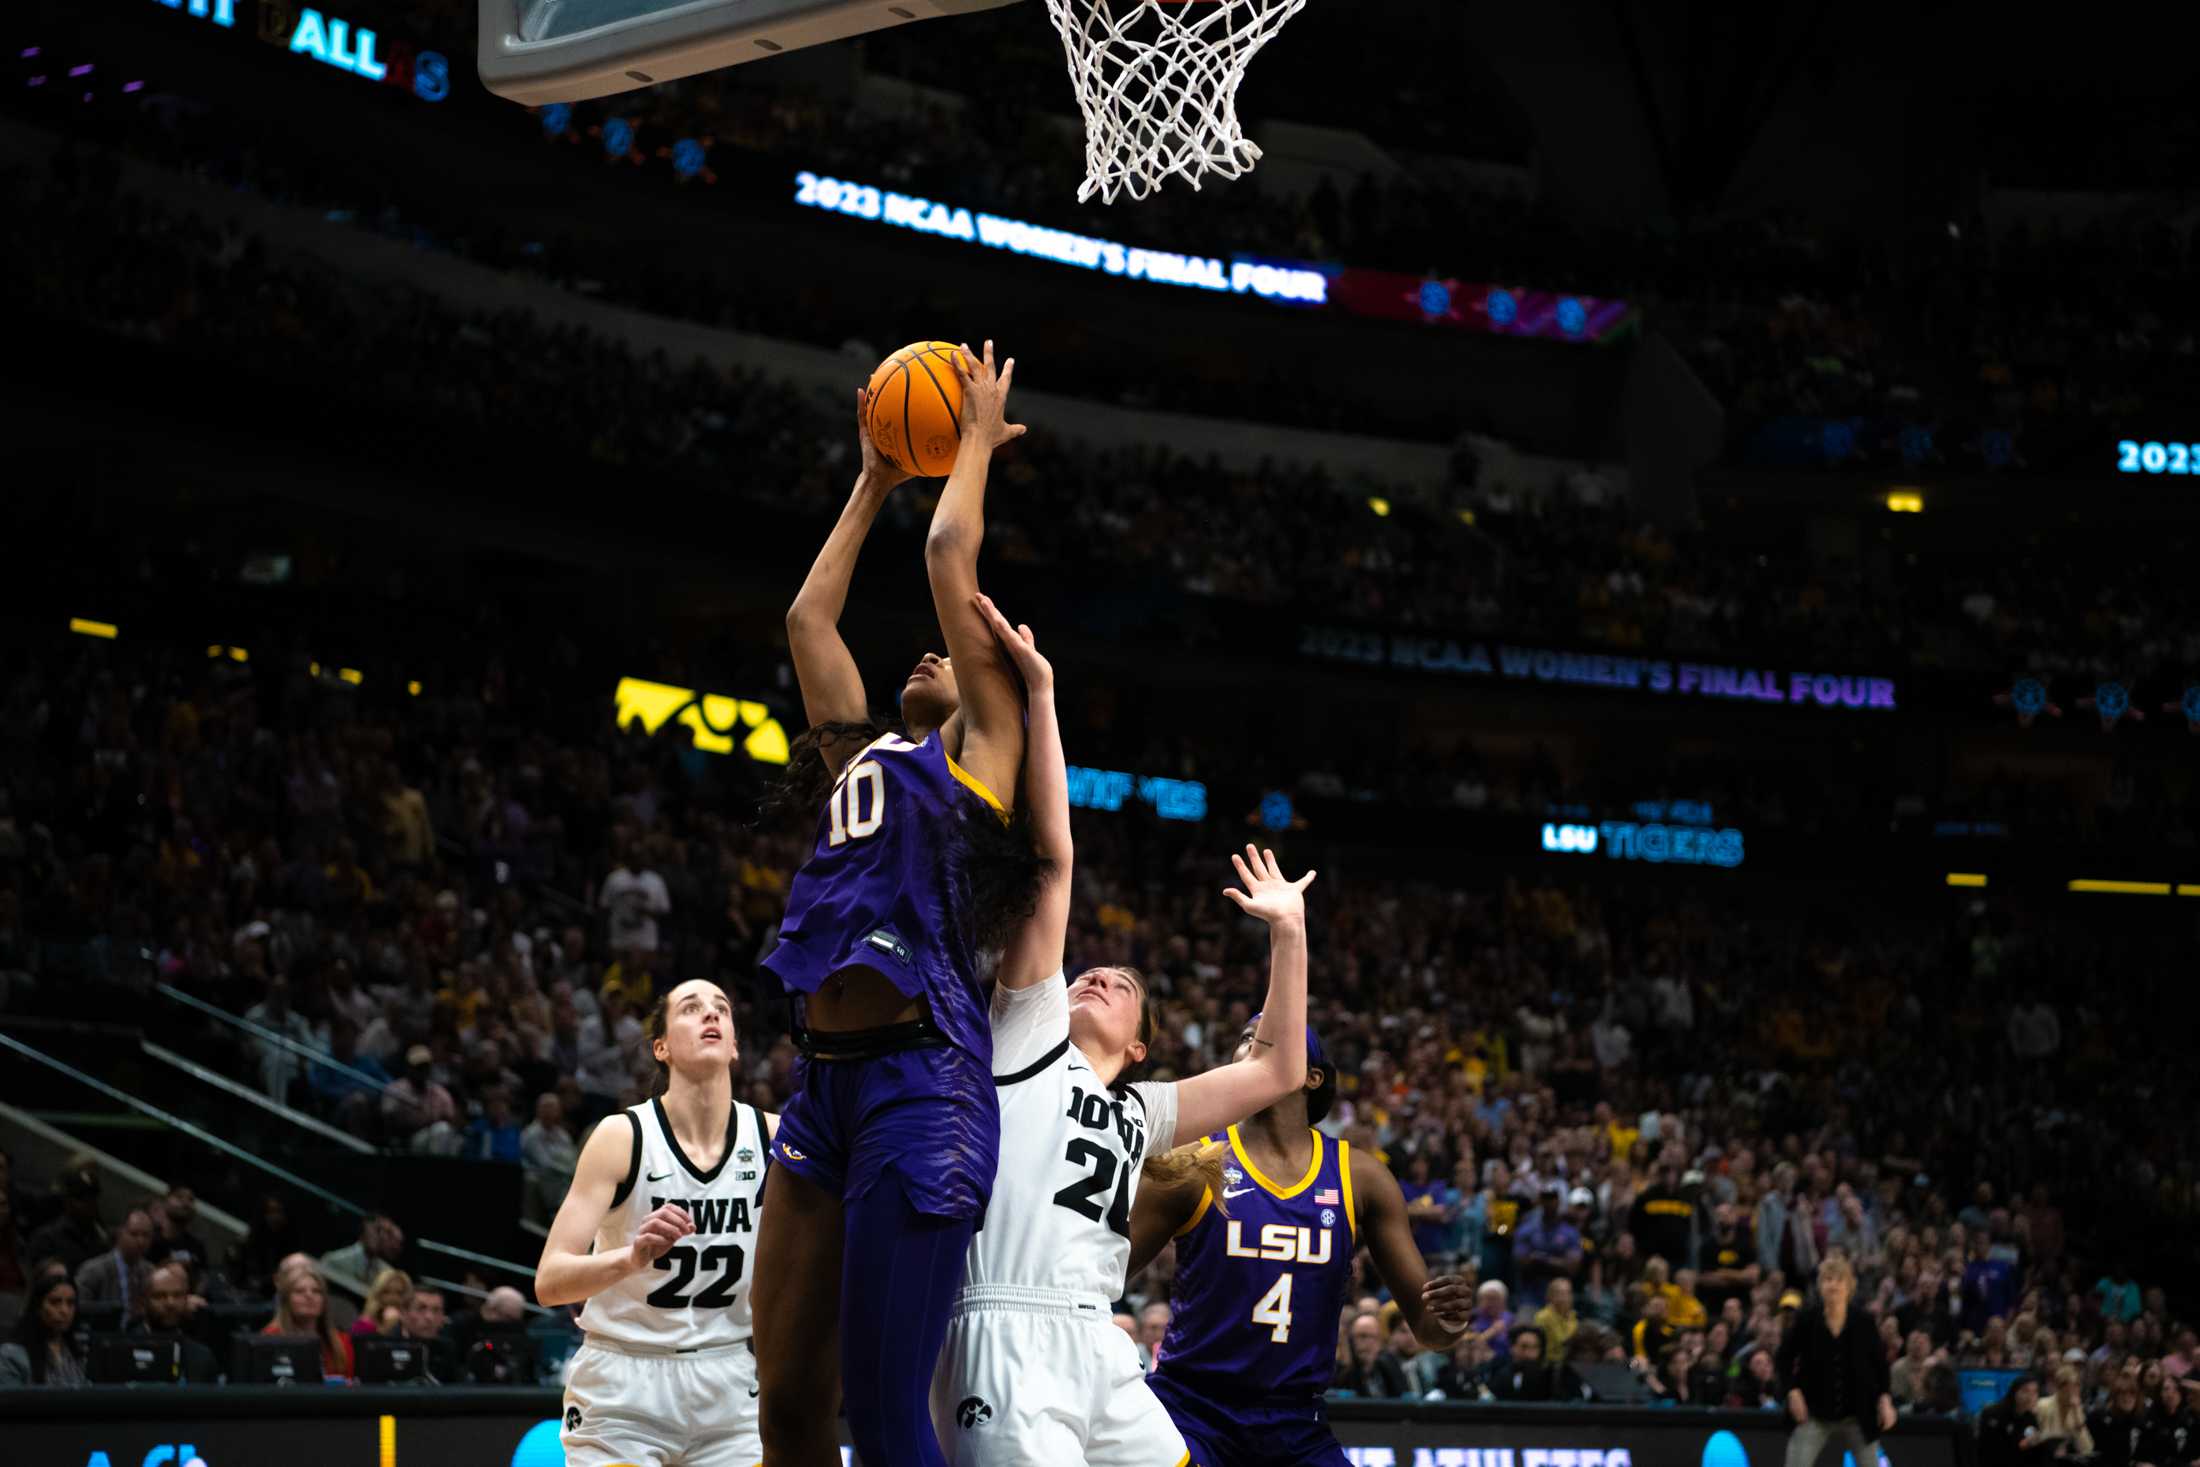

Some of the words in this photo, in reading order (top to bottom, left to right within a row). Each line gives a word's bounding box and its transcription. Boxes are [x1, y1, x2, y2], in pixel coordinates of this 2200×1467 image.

[795, 171, 881, 220] 2023
[882, 191, 975, 242] NCAA
[976, 213, 1126, 277] WOMEN'S
[1127, 247, 1229, 292] FINAL
[1230, 262, 1328, 305] FOUR
[1391, 637, 1493, 673] NCAA
[1499, 645, 1671, 692] WOMEN'S
[1679, 662, 1785, 702] FINAL
[1789, 672, 1896, 710] FOUR
[829, 759, 885, 848] 10
[1542, 822, 1599, 853] LSU
[647, 1244, 745, 1309] 22
[1226, 1220, 1332, 1264] LSU
[1252, 1272, 1293, 1343] 4
